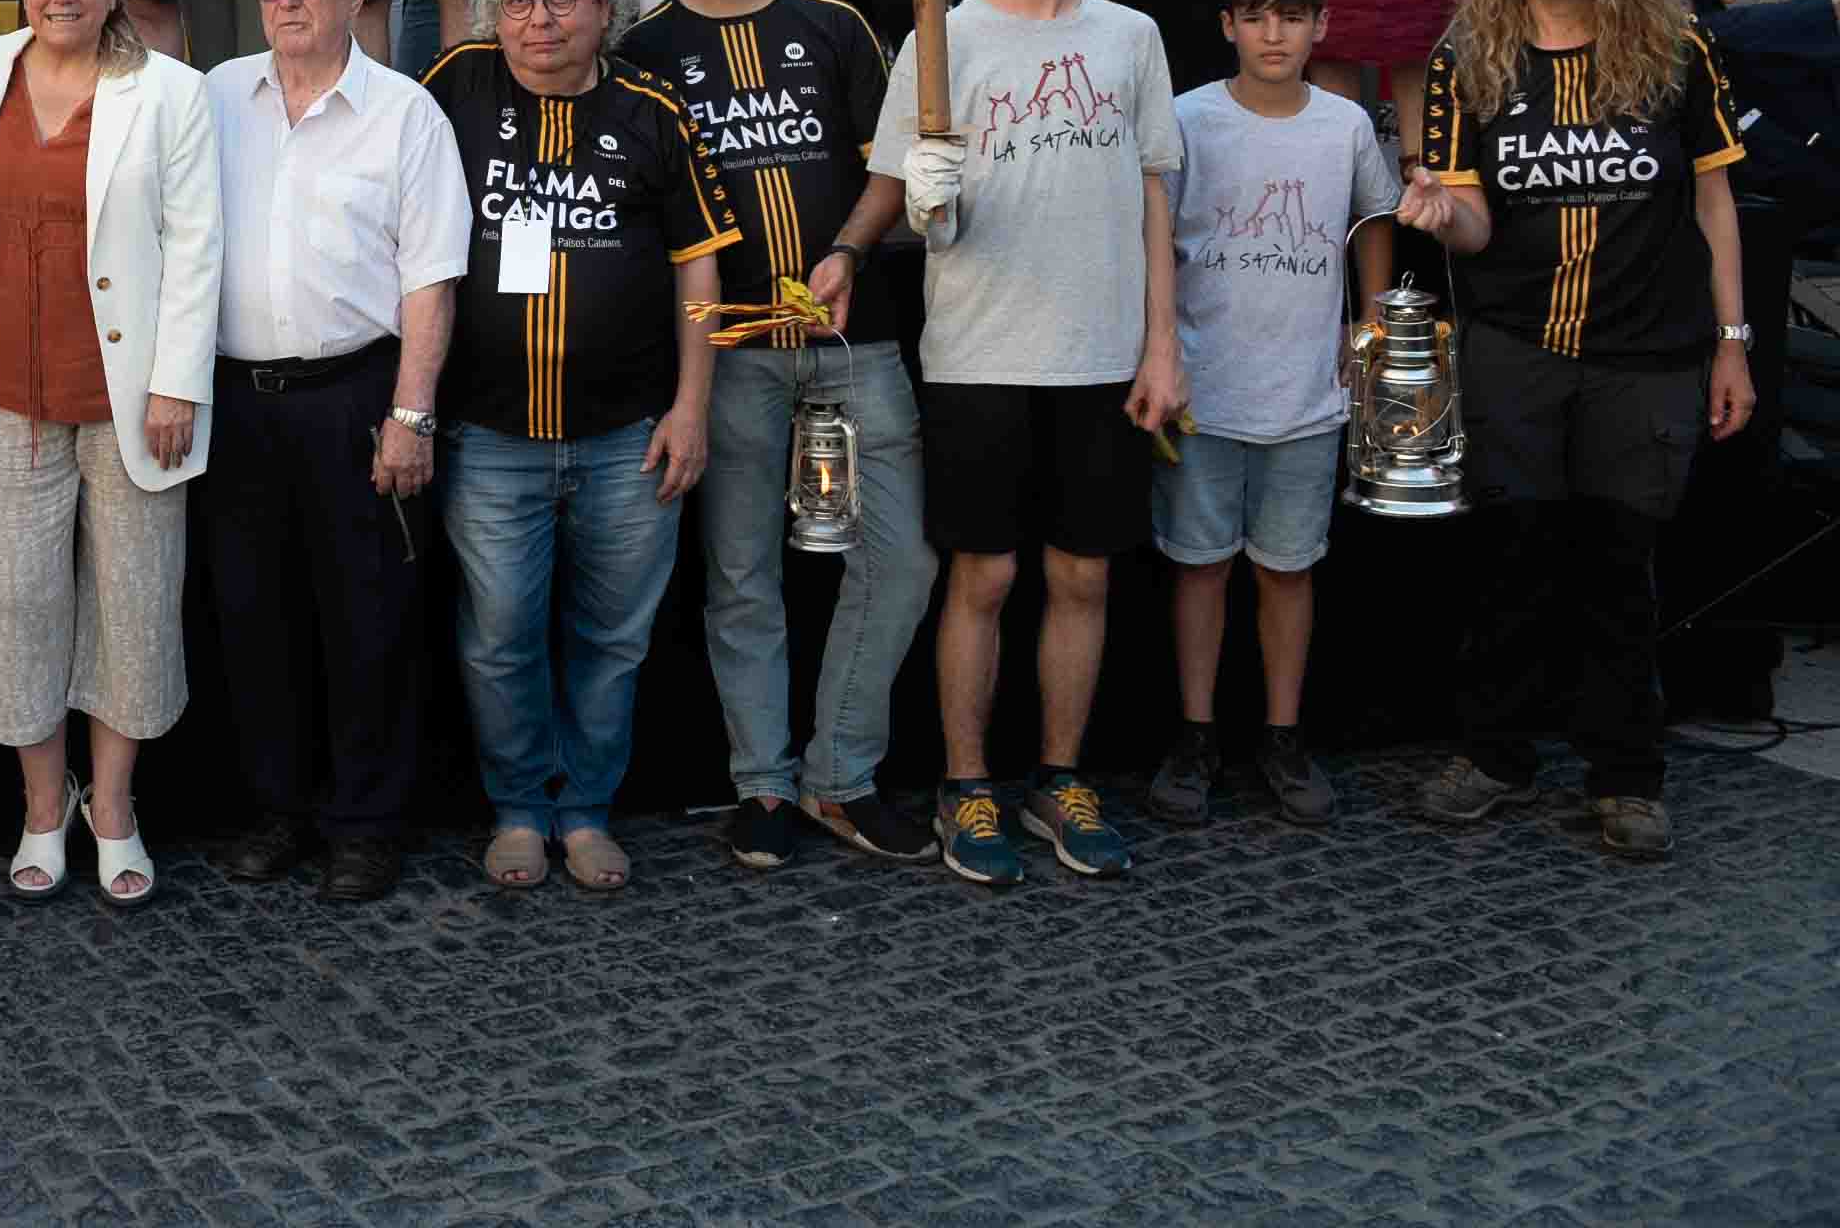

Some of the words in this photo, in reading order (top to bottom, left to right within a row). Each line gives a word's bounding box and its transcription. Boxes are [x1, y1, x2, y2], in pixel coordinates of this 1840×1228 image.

[688, 88, 800, 124] FLAMA
[993, 139, 1016, 163] LA
[1497, 127, 1632, 162] FLAMA
[485, 159, 602, 203] FLAMA
[608, 177, 627, 189] DEL
[1496, 147, 1659, 190] CANIGÓ
[480, 192, 618, 230] CANIGÓ
